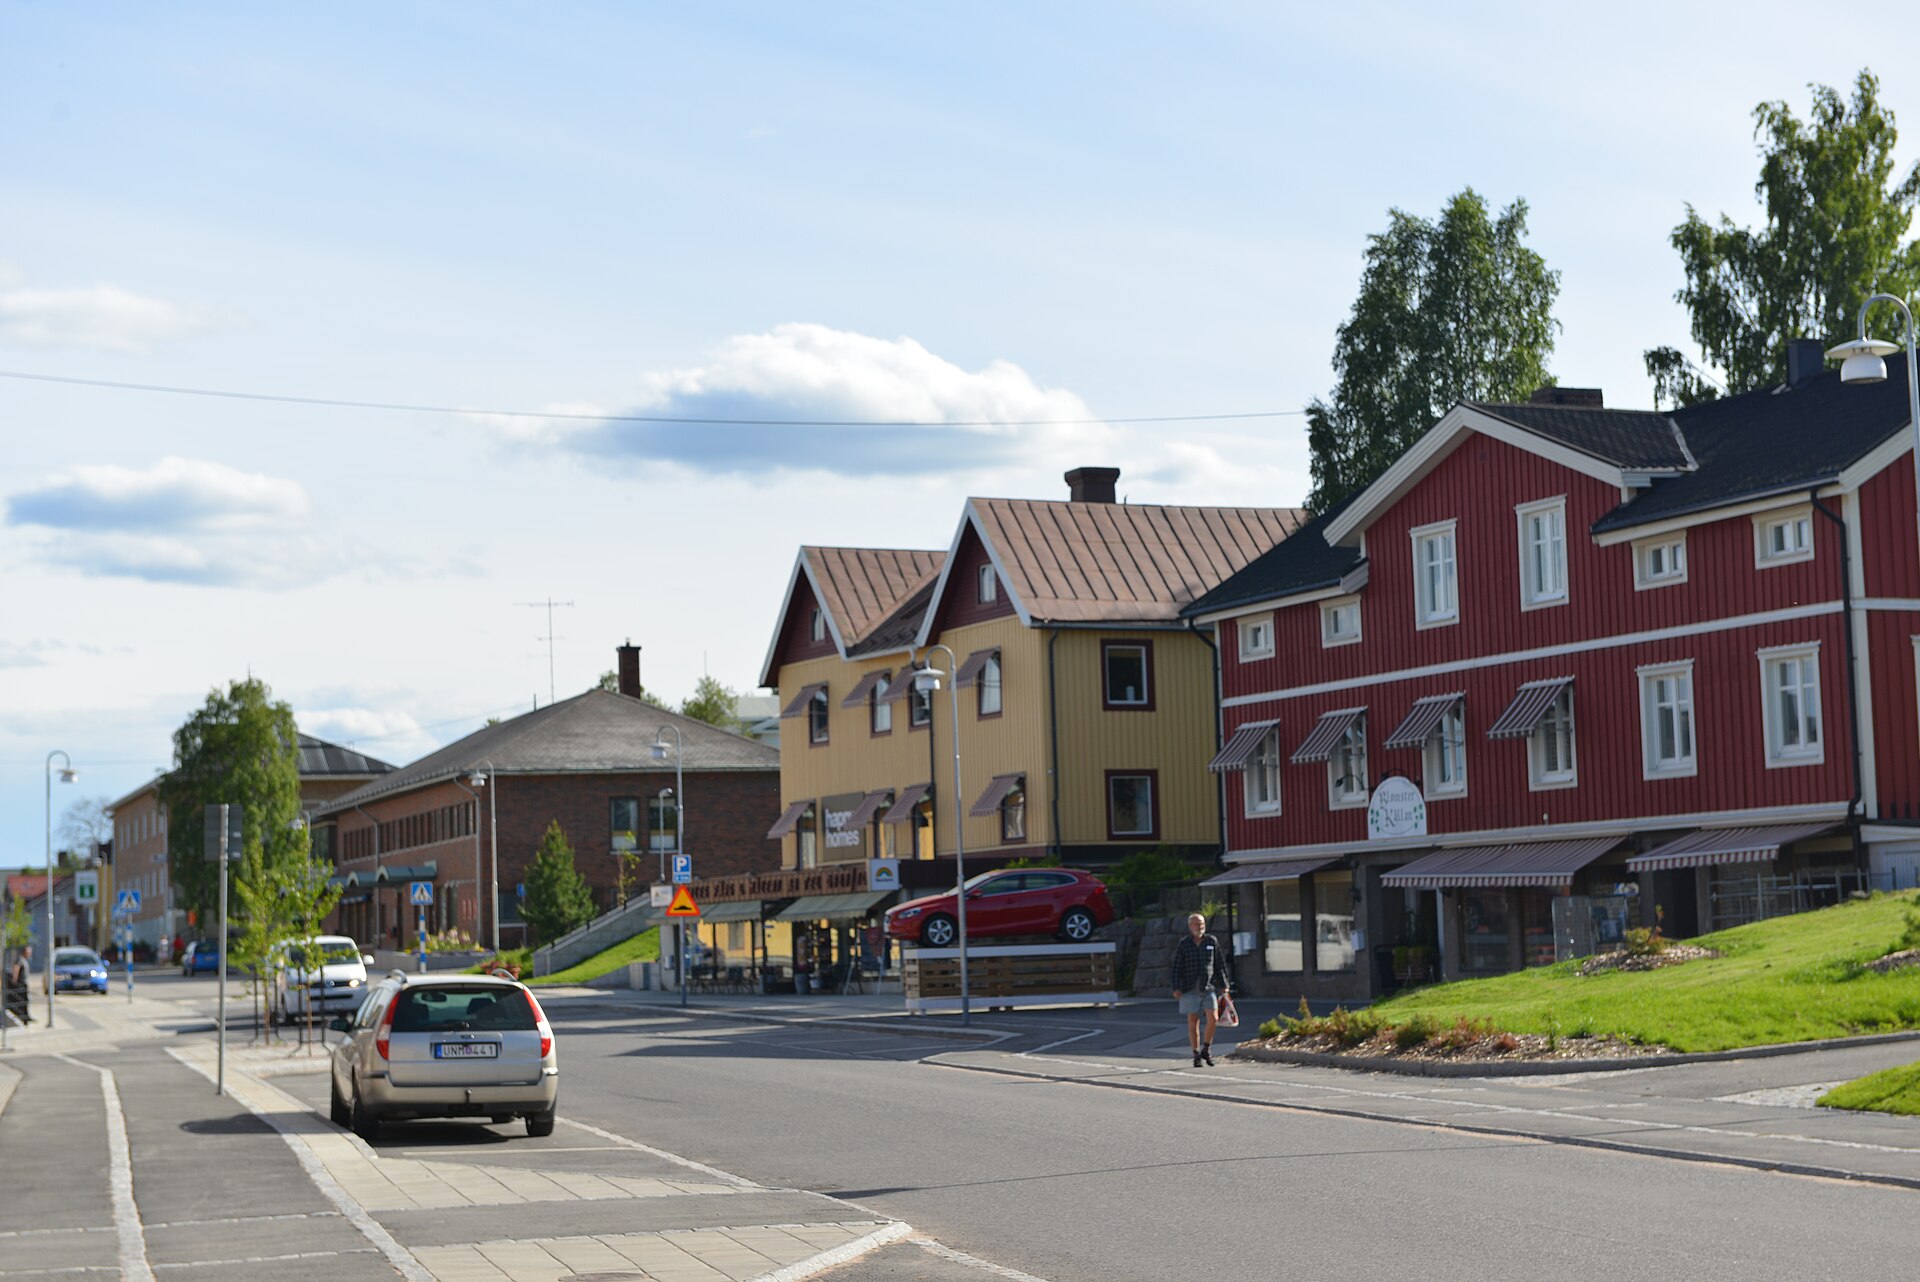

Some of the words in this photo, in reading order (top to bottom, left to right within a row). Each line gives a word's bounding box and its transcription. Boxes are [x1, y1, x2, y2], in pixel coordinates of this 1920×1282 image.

[825, 808, 854, 831] hap
[825, 829, 860, 849] homes
[676, 857, 688, 872] P
